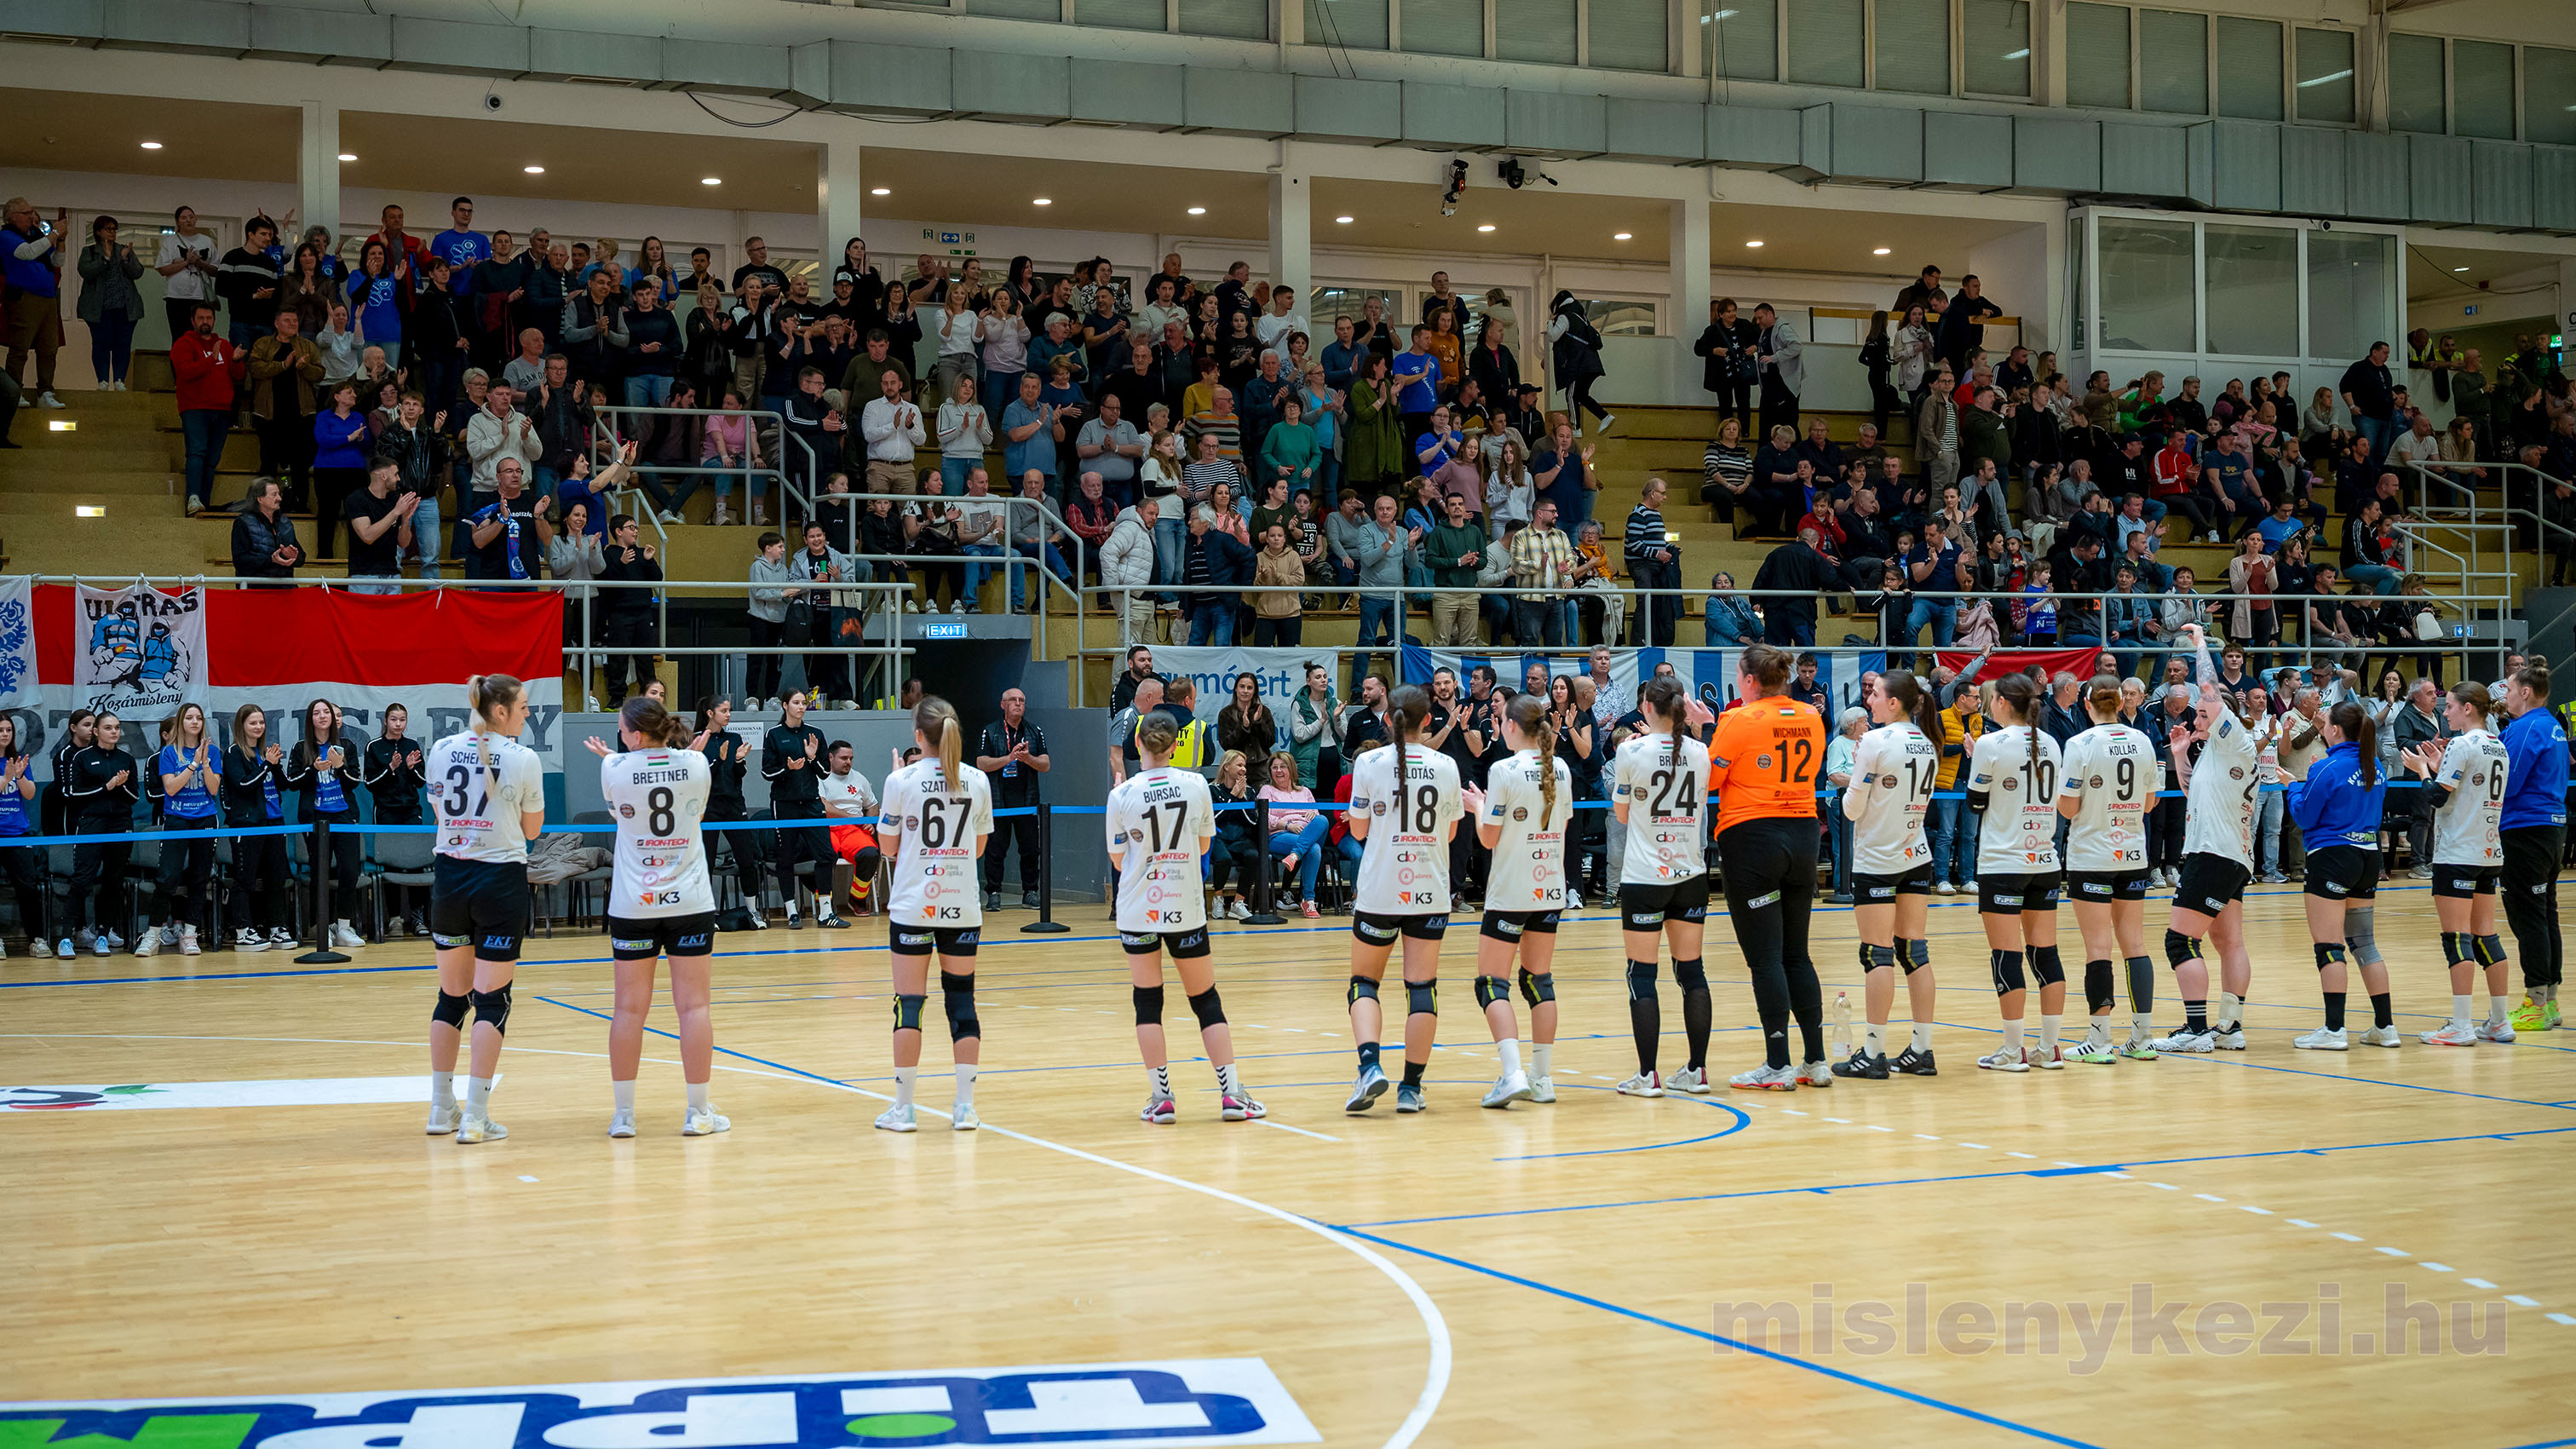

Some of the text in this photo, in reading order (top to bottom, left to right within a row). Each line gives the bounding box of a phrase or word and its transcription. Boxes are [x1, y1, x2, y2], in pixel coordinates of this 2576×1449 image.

[930, 625, 962, 635] EXIT
[87, 692, 183, 712] Kozármisleny
[1773, 727, 1812, 739] WICHMANN
[1905, 743, 1935, 756] KECSKÉS
[2108, 743, 2138, 756] KOLLÁR
[451, 751, 501, 766] SCHEER
[1659, 755, 1688, 767] BRDA
[1775, 739, 1812, 783] 12
[633, 768, 689, 785] BRETTNER
[1394, 766, 1435, 779] PLOTÁS
[1905, 757, 1935, 802] 14
[2117, 757, 2135, 801] 9
[2020, 759, 2056, 803] 10
[2489, 760, 2504, 801] 6
[444, 765, 501, 818] 37
[1143, 786, 1182, 803] BURSAC
[1650, 770, 1697, 817] 24
[648, 786, 676, 837] 8
[1393, 785, 1438, 833] 18
[922, 797, 972, 848] 67
[1141, 800, 1187, 853] 17
[1659, 816, 1696, 825] IRON-TECH
[645, 837, 689, 847] IRON-TECH
[1915, 843, 1928, 857] K3
[2126, 850, 2141, 861] K3
[2038, 853, 2052, 864] K3
[658, 891, 681, 905] K3
[1415, 893, 1433, 905] K3
[1546, 888, 1561, 900] K3
[940, 907, 961, 919] K3
[1164, 911, 1182, 923] K3
